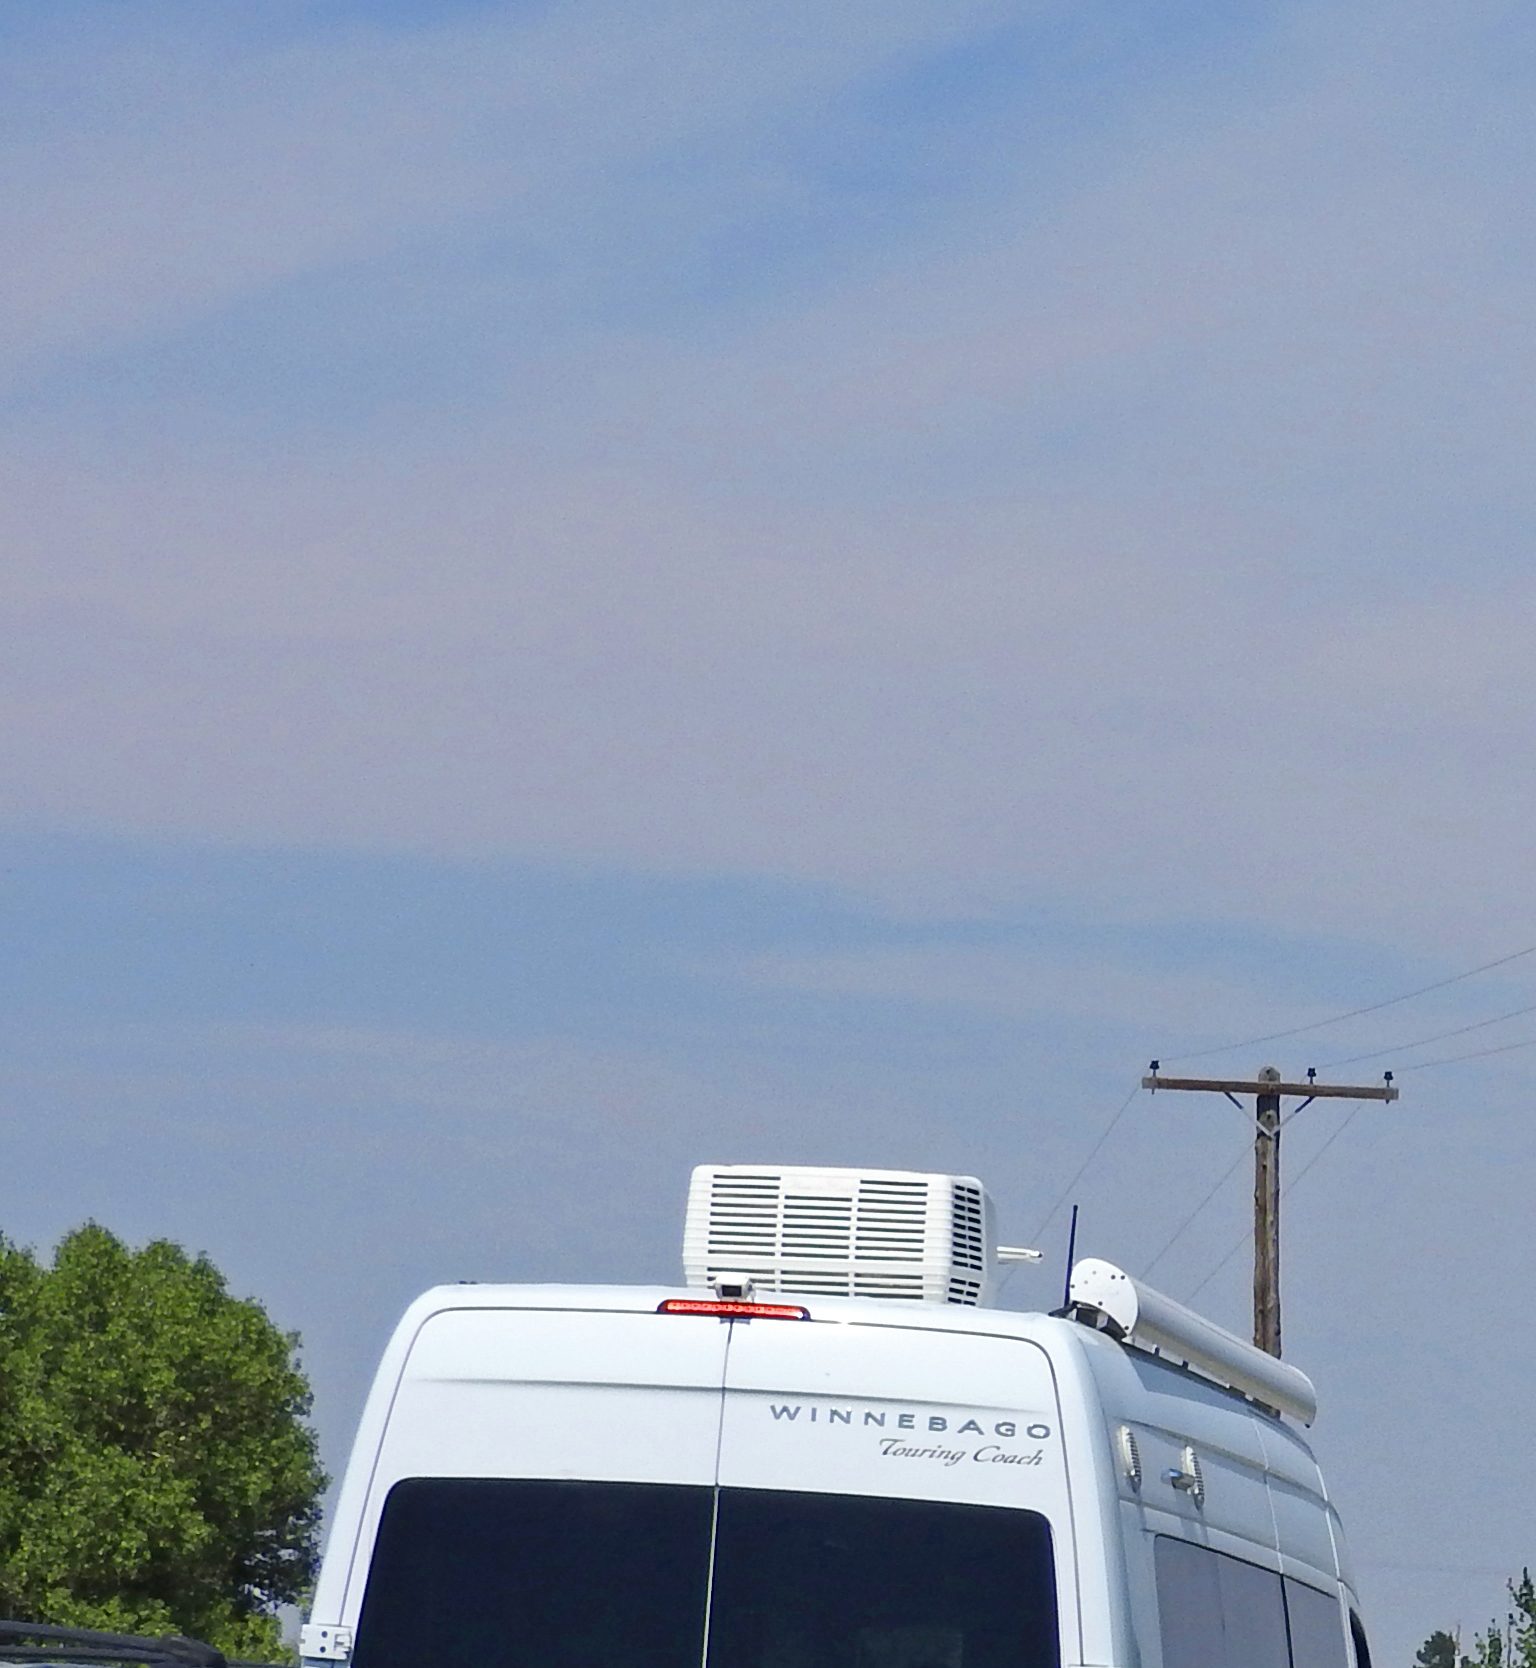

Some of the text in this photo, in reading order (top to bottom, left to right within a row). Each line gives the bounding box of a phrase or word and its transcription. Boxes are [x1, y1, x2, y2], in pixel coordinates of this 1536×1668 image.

[769, 1404, 1052, 1440] WINNEBAGO
[878, 1437, 1044, 1467] Touring Coach
